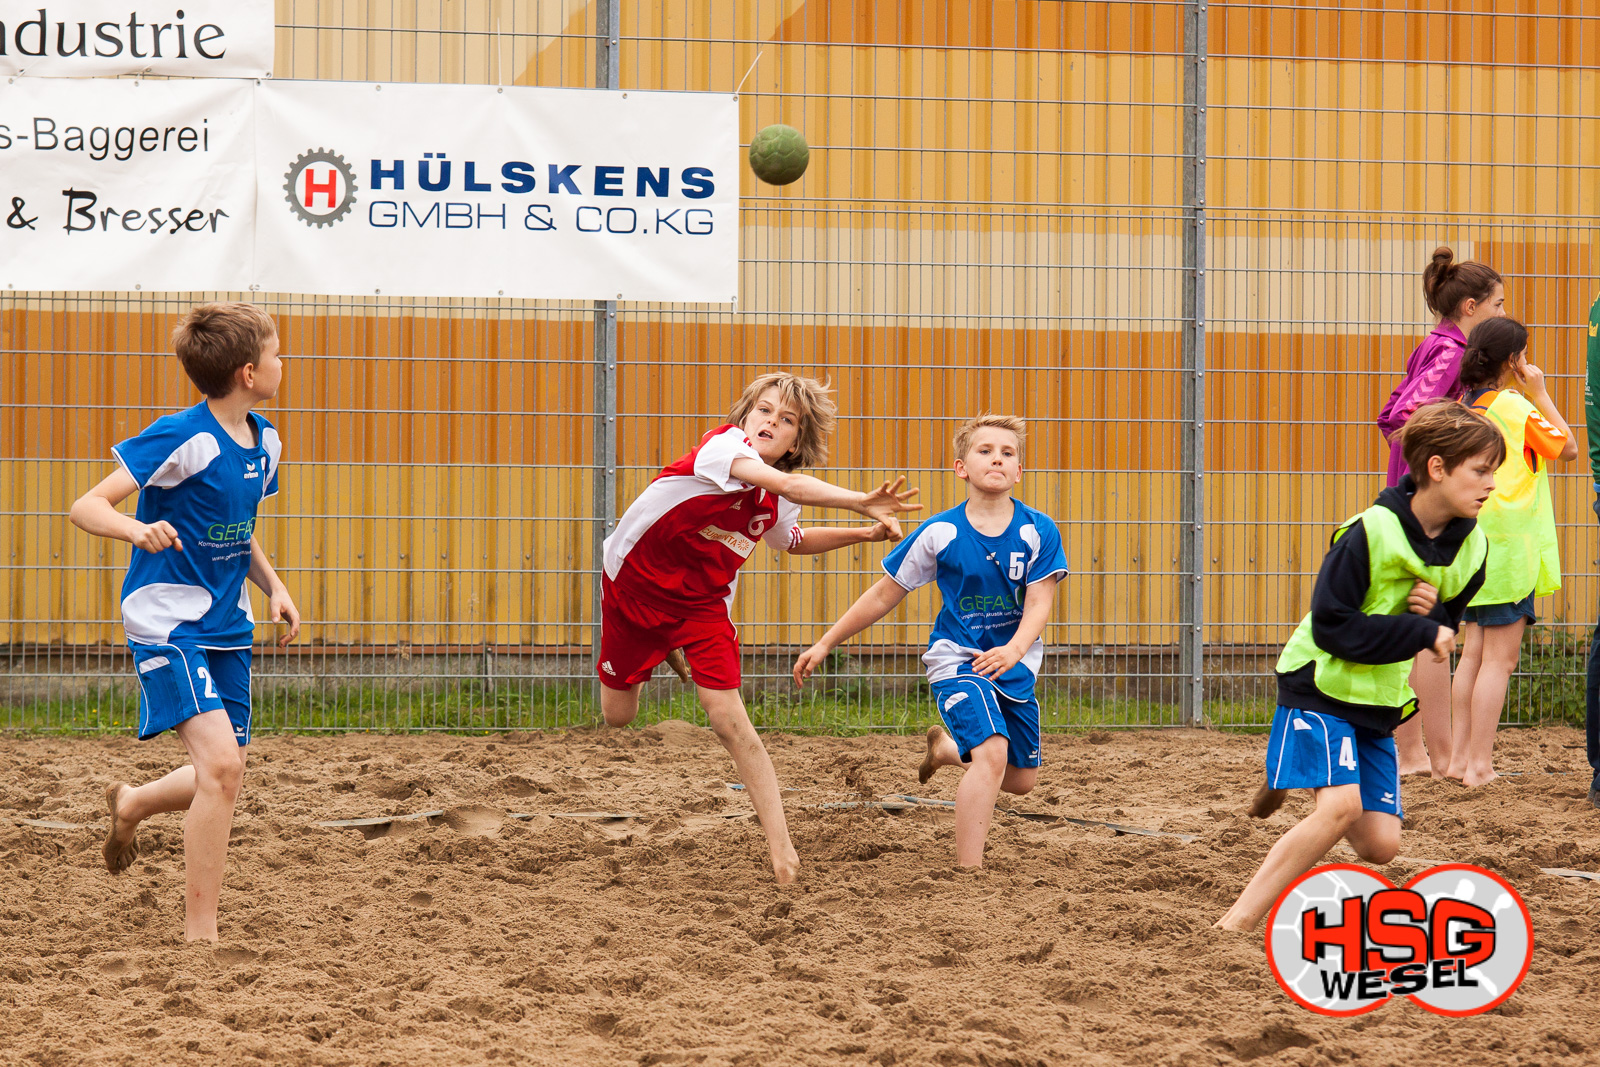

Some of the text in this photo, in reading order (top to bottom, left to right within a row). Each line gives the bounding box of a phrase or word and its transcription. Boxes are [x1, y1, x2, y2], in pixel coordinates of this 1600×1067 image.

[0, 8, 227, 60] dustrie
[304, 152, 716, 208] H HÜLSKENS
[6, 187, 230, 235] & Bresser
[368, 200, 715, 236] GMBH & CO.KG
[747, 513, 772, 536] 6
[1008, 551, 1026, 581] 5
[196, 666, 219, 699] 2
[1338, 736, 1358, 771] 4
